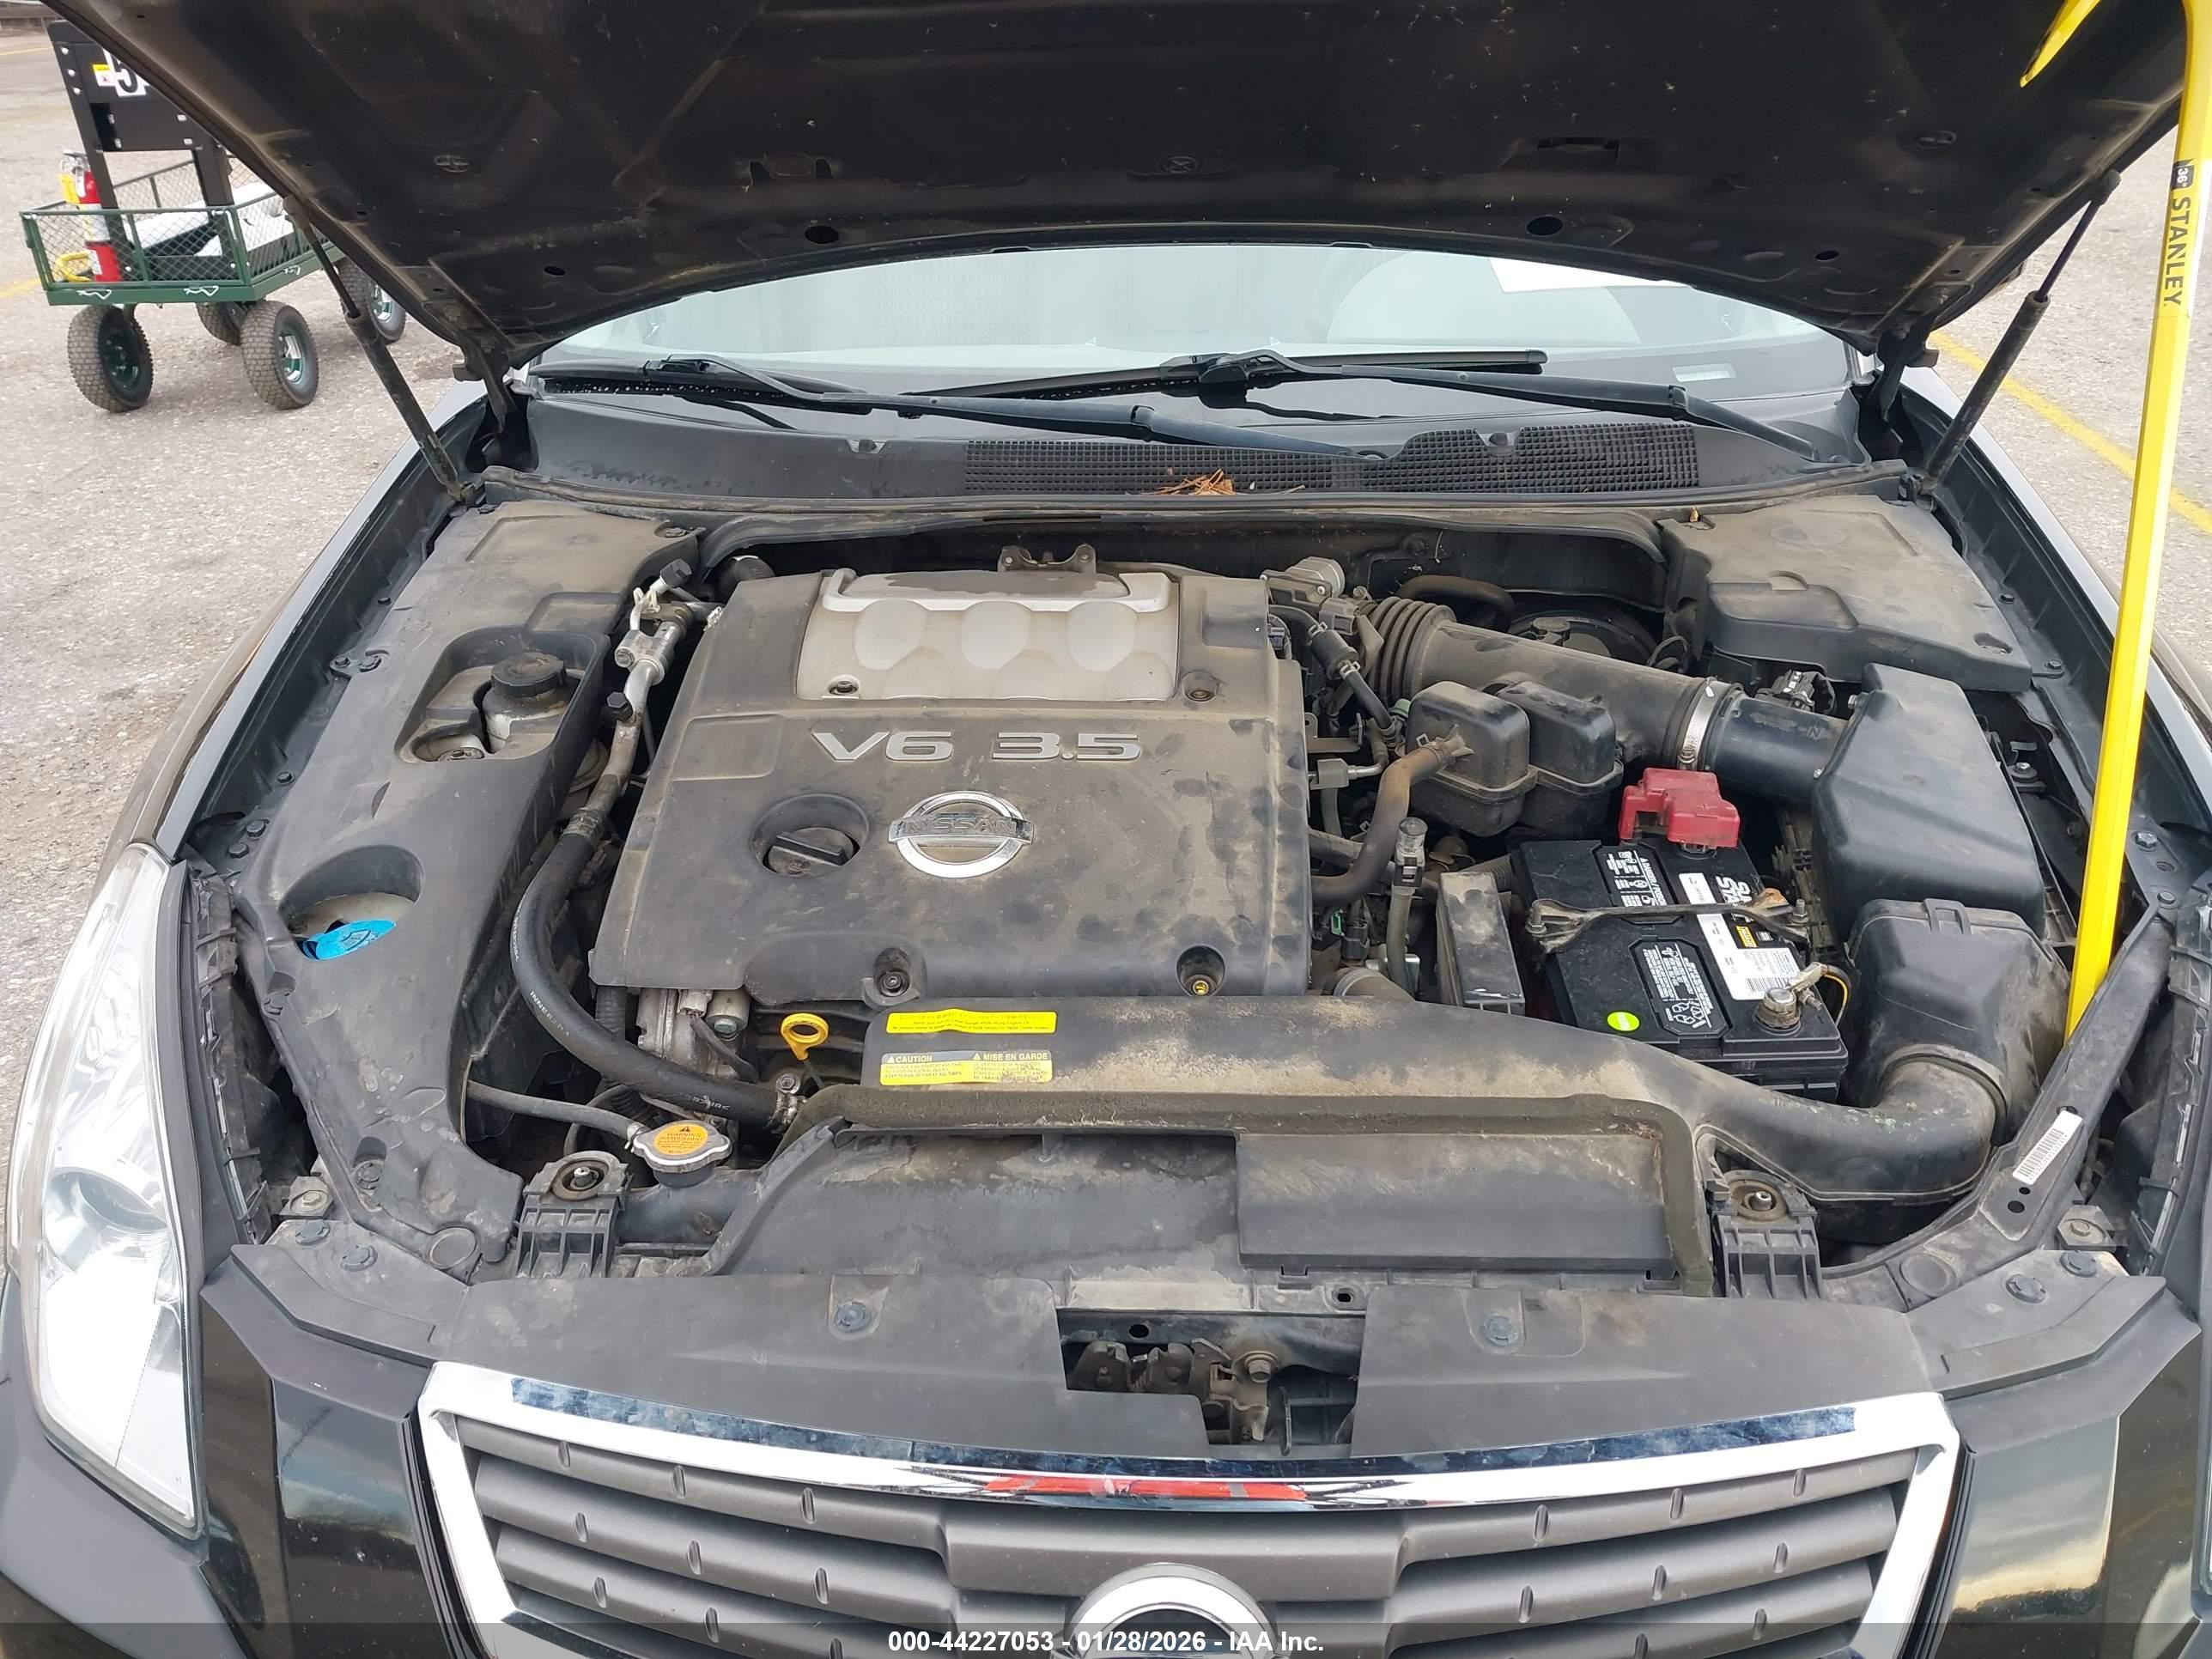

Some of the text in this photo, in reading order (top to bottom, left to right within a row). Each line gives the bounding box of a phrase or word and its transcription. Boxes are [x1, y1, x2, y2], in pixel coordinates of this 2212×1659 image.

[2163, 196, 2191, 307] STANLEY
[811, 731, 1142, 761] V6 3.5
[905, 817, 1017, 836] NISSAN
